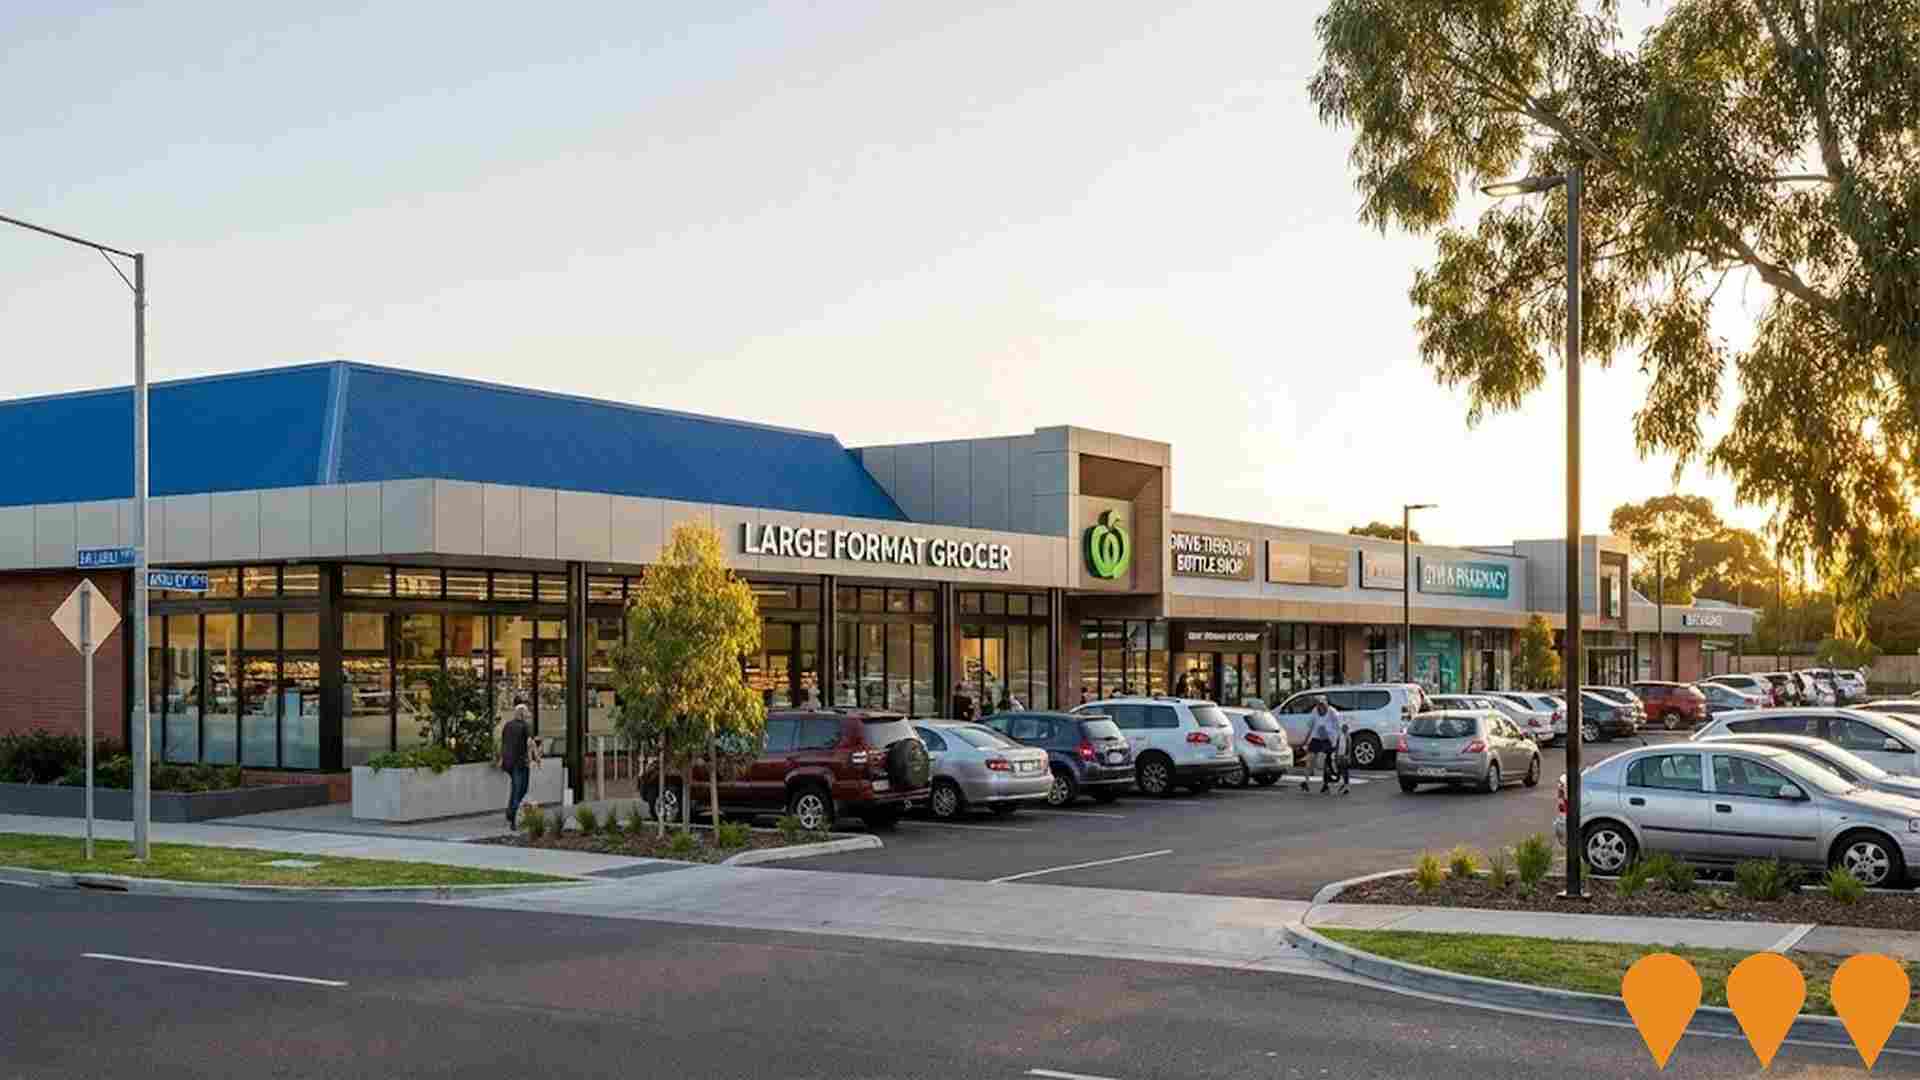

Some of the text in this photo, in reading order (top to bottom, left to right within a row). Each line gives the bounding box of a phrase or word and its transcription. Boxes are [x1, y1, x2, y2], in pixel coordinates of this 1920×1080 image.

[743, 522, 1013, 571] LARGE FORMAT GROCER
